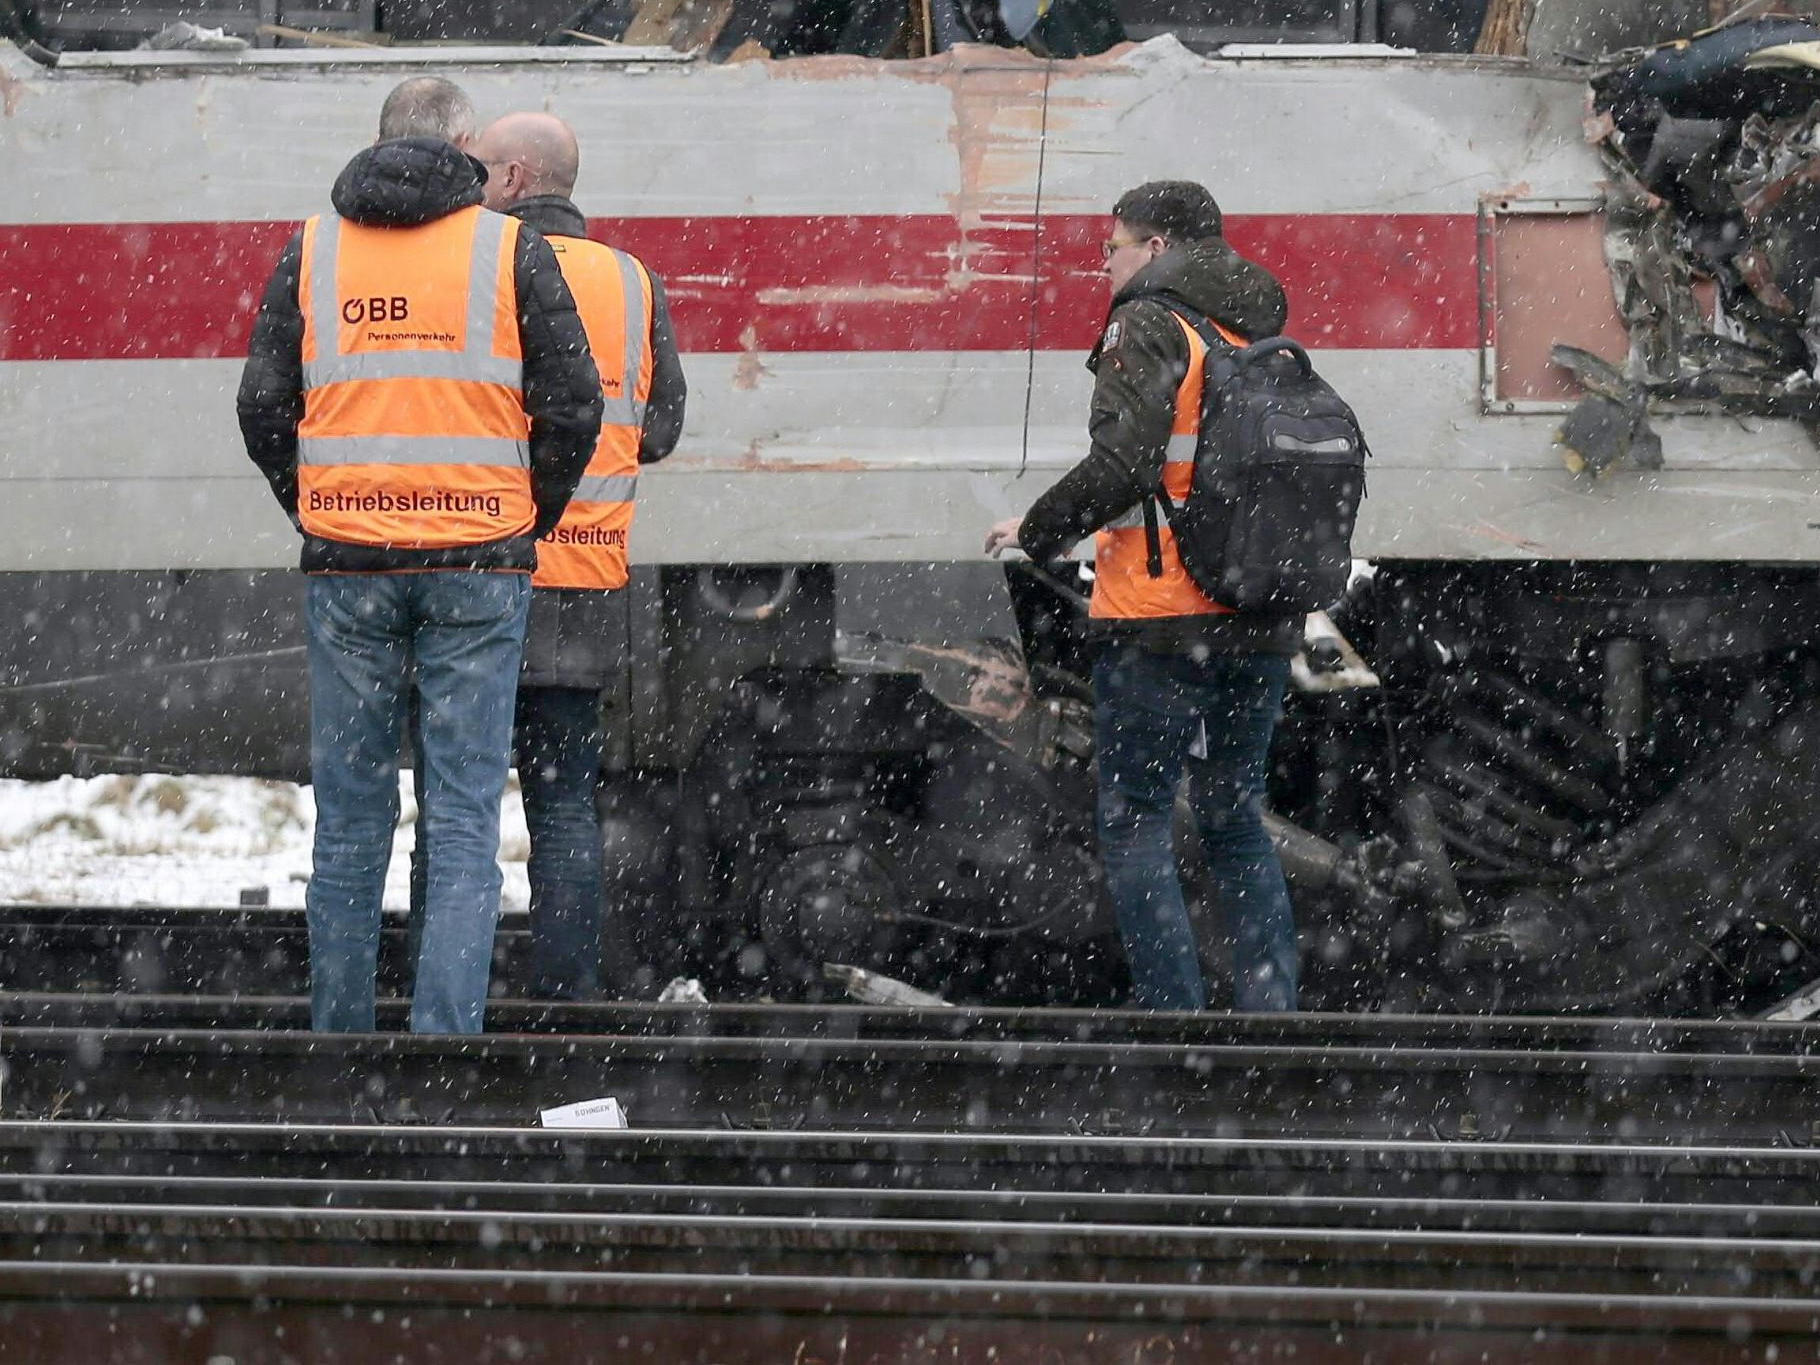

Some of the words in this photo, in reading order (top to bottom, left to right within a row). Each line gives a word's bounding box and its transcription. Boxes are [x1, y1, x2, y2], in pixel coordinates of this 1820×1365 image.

[342, 296, 408, 324] ÖBB
[367, 332, 456, 342] Personenverkehr
[309, 490, 501, 517] Betriebsleitung
